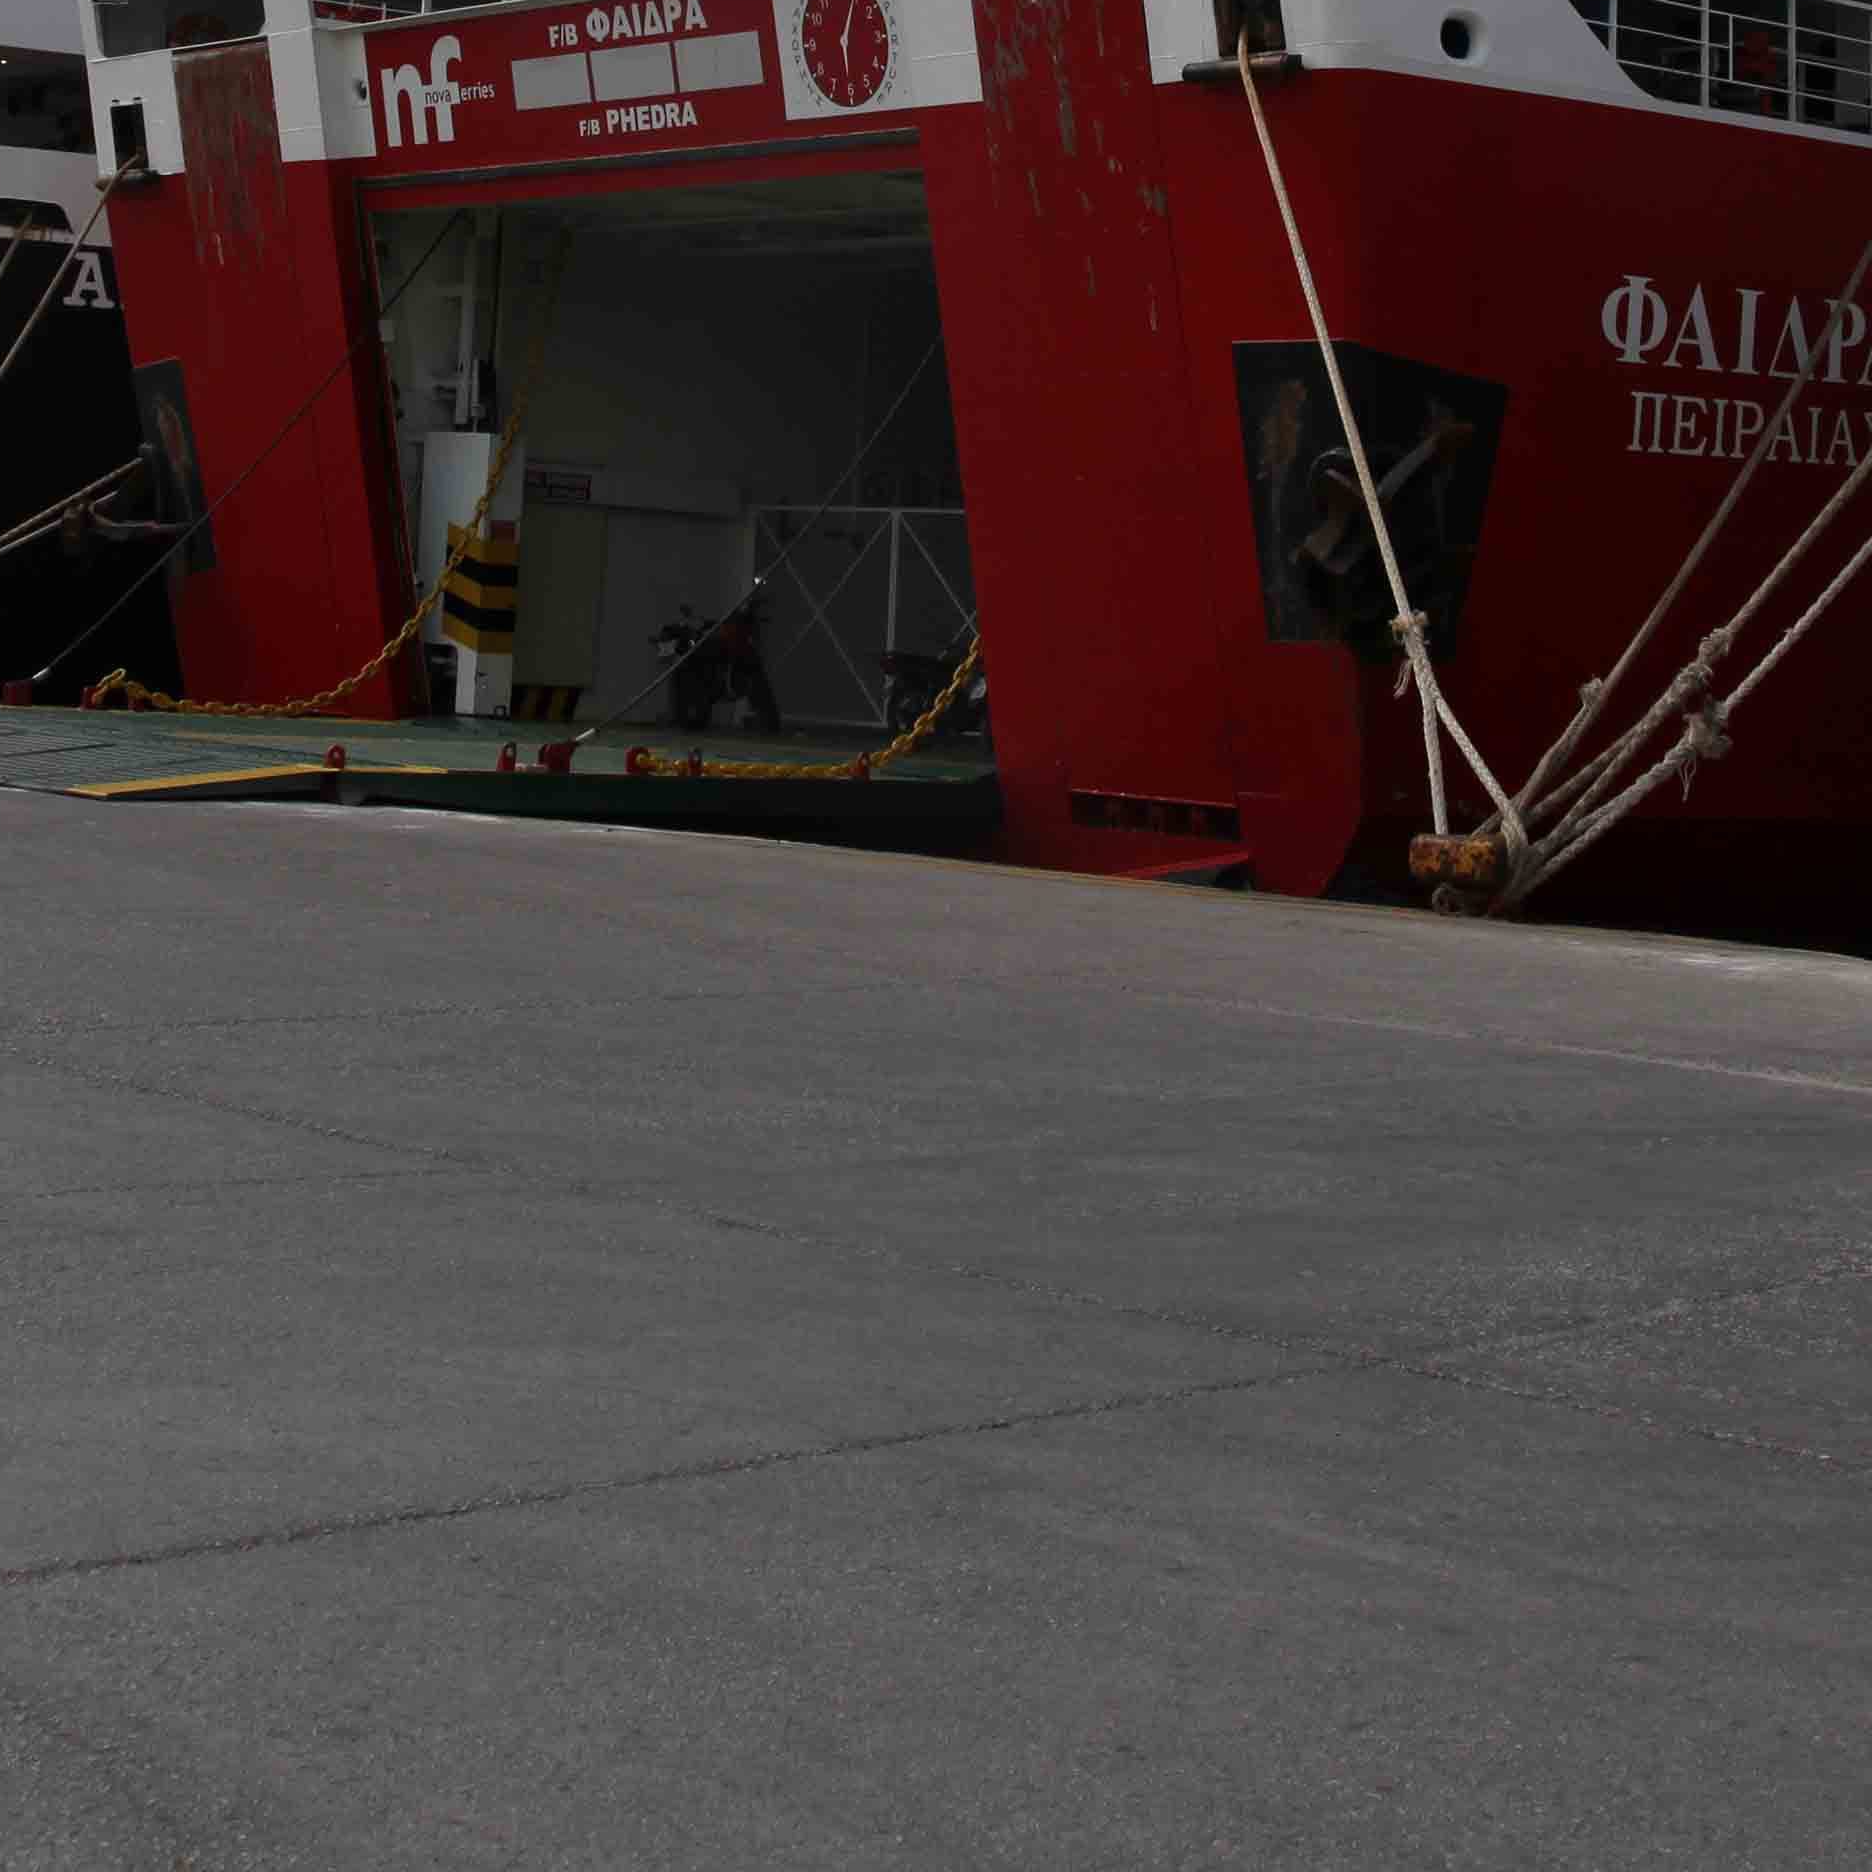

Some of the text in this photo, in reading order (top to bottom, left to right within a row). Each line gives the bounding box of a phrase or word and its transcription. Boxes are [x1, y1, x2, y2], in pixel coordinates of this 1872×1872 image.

[548, 23, 578, 48] F/B
[425, 89, 451, 105] nova
[579, 100, 699, 137] F/B PHEDRA
